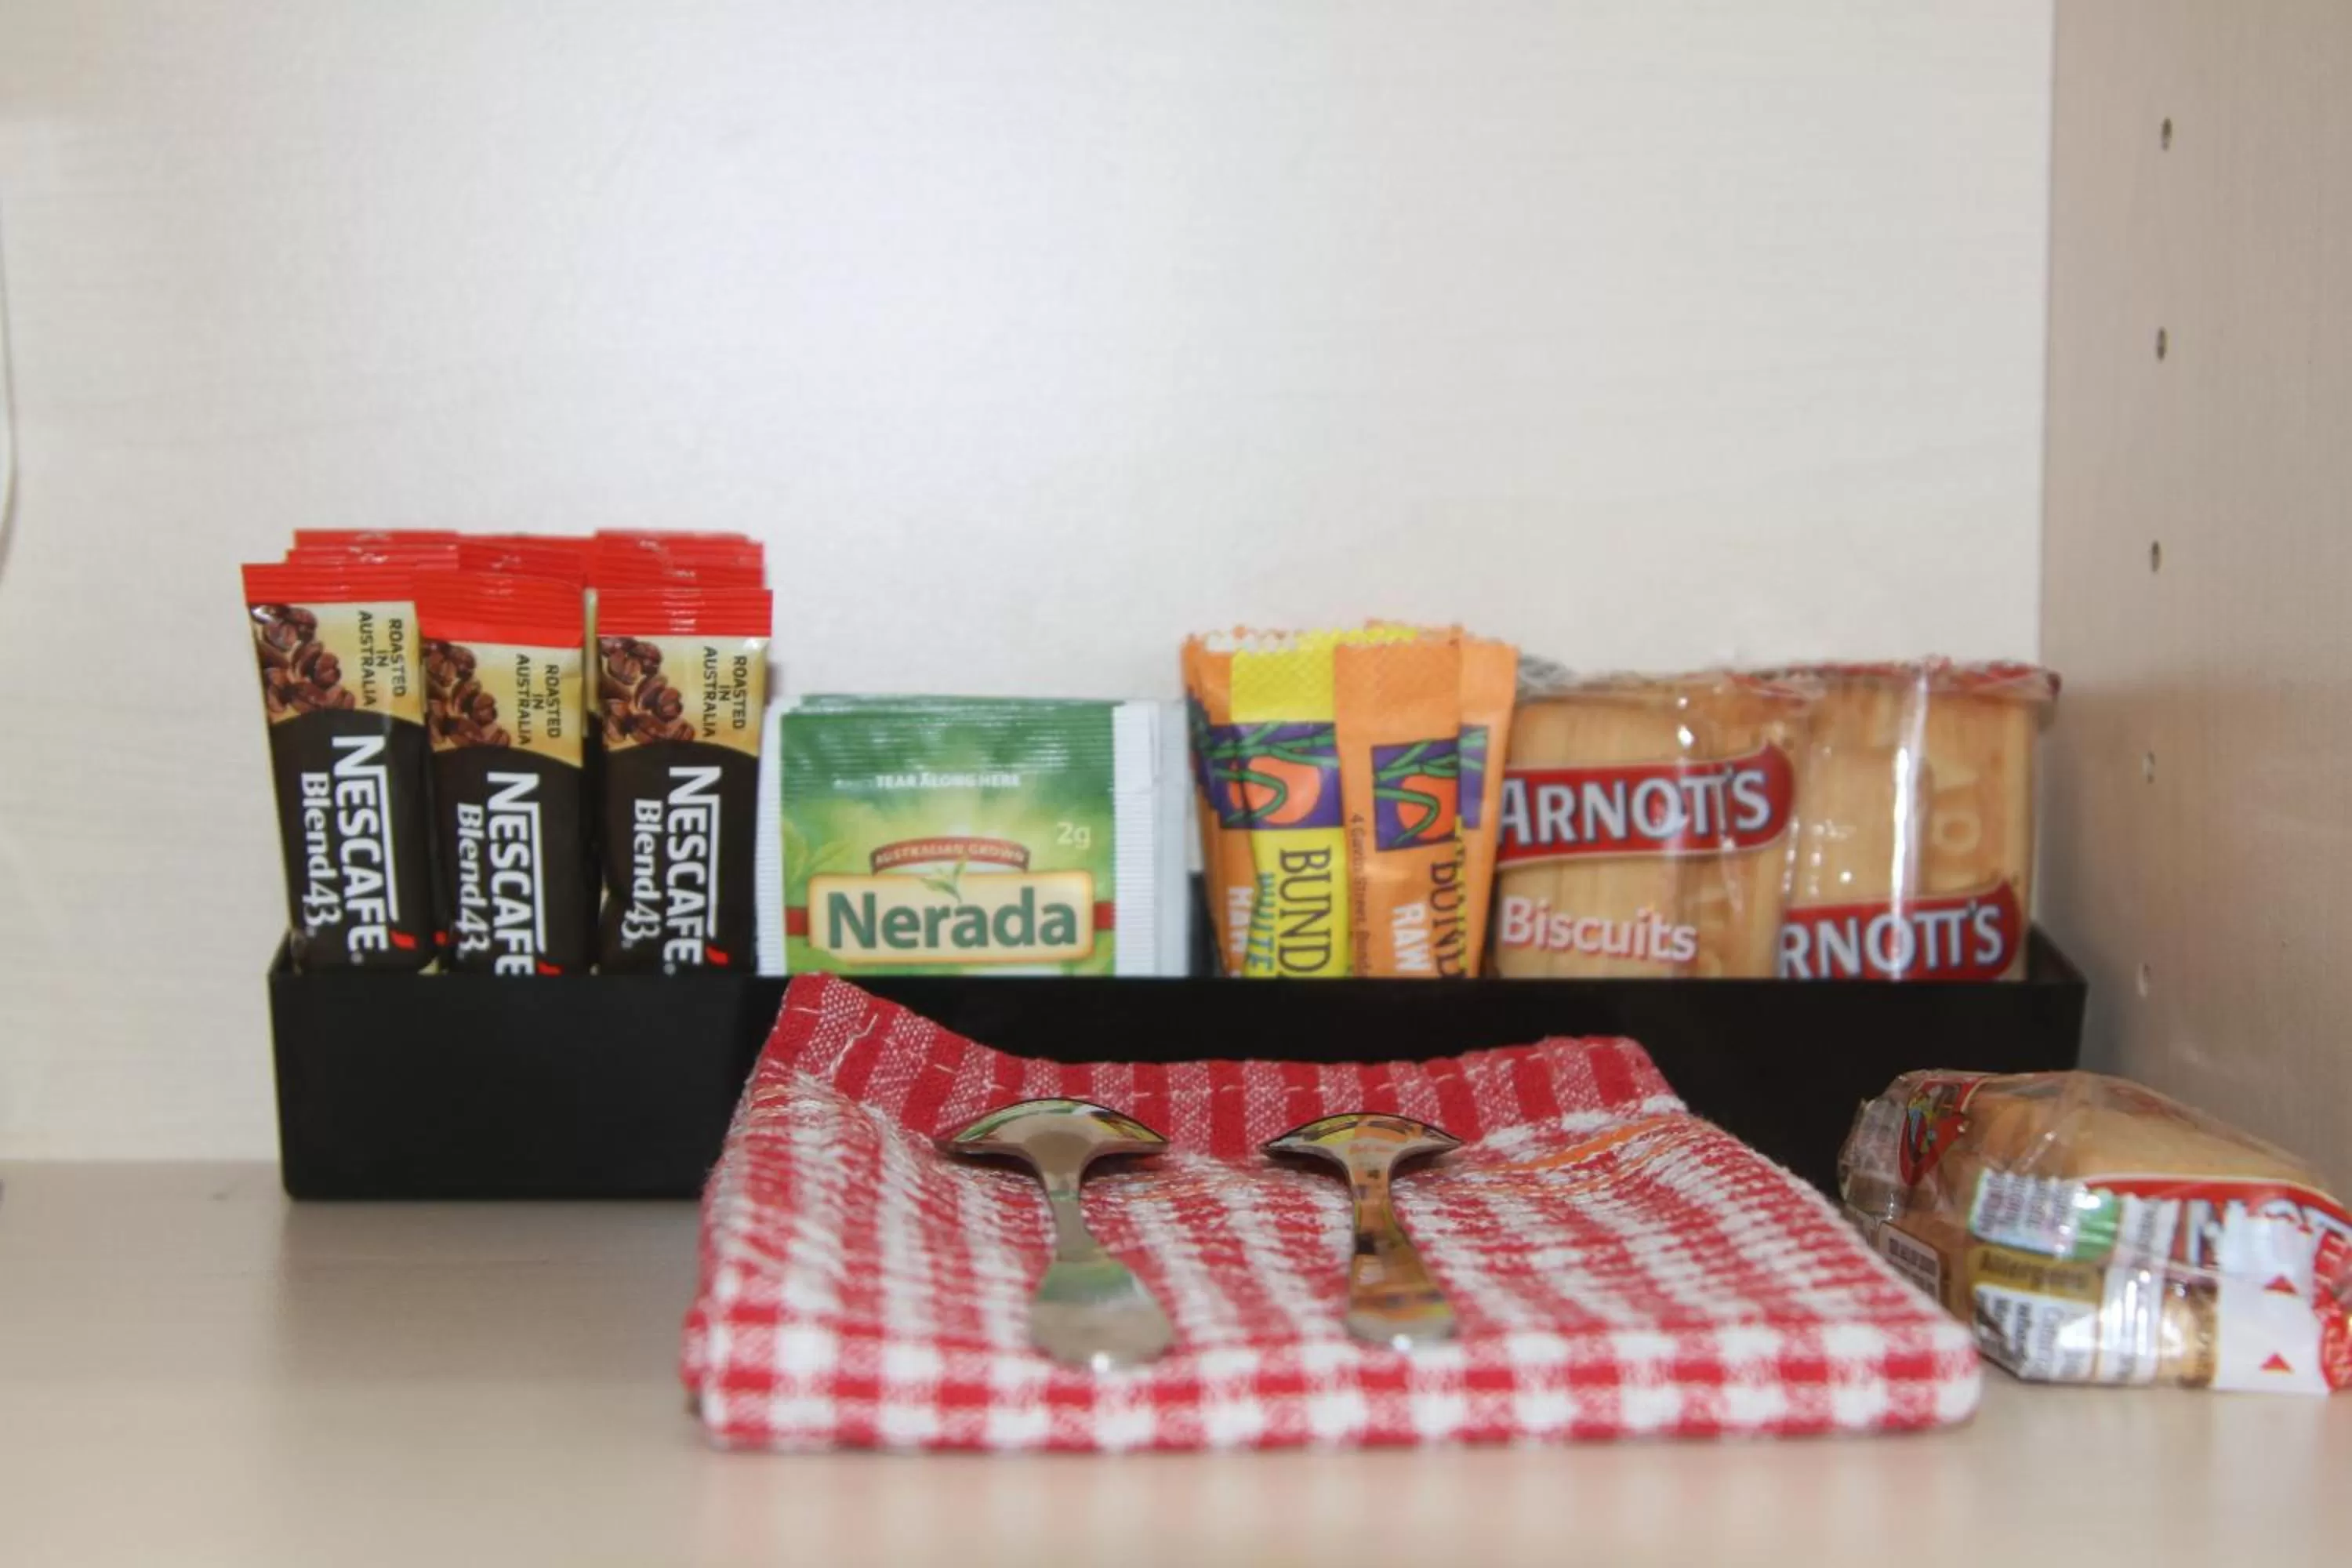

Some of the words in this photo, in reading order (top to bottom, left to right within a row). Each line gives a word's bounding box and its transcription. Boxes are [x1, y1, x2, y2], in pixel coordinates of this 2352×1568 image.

[358, 610, 379, 706] AUSTRALIA
[377, 648, 388, 668] IN
[387, 618, 407, 698] ROASTED
[702, 645, 717, 738] AUSTRALIA
[718, 684, 730, 702] IN
[732, 655, 747, 730] ROASTED
[515, 653, 531, 746] AUSTRALIA
[532, 692, 543, 710] IN
[544, 663, 562, 739] ROASTED
[876, 774, 917, 789] TEAR
[978, 772, 1020, 788] HERE
[1499, 768, 1772, 845] ARNOTT'S
[875, 843, 964, 867] AUSTRALIAN
[968, 844, 1025, 863] GROWN
[1056, 821, 1091, 849] 2g
[826, 887, 1077, 950] Nerada
[1278, 845, 1331, 978] BUND
[1392, 902, 1432, 973] RAW
[1501, 895, 1698, 962] Biscuits
[1780, 901, 2004, 978] RNOTT'S
